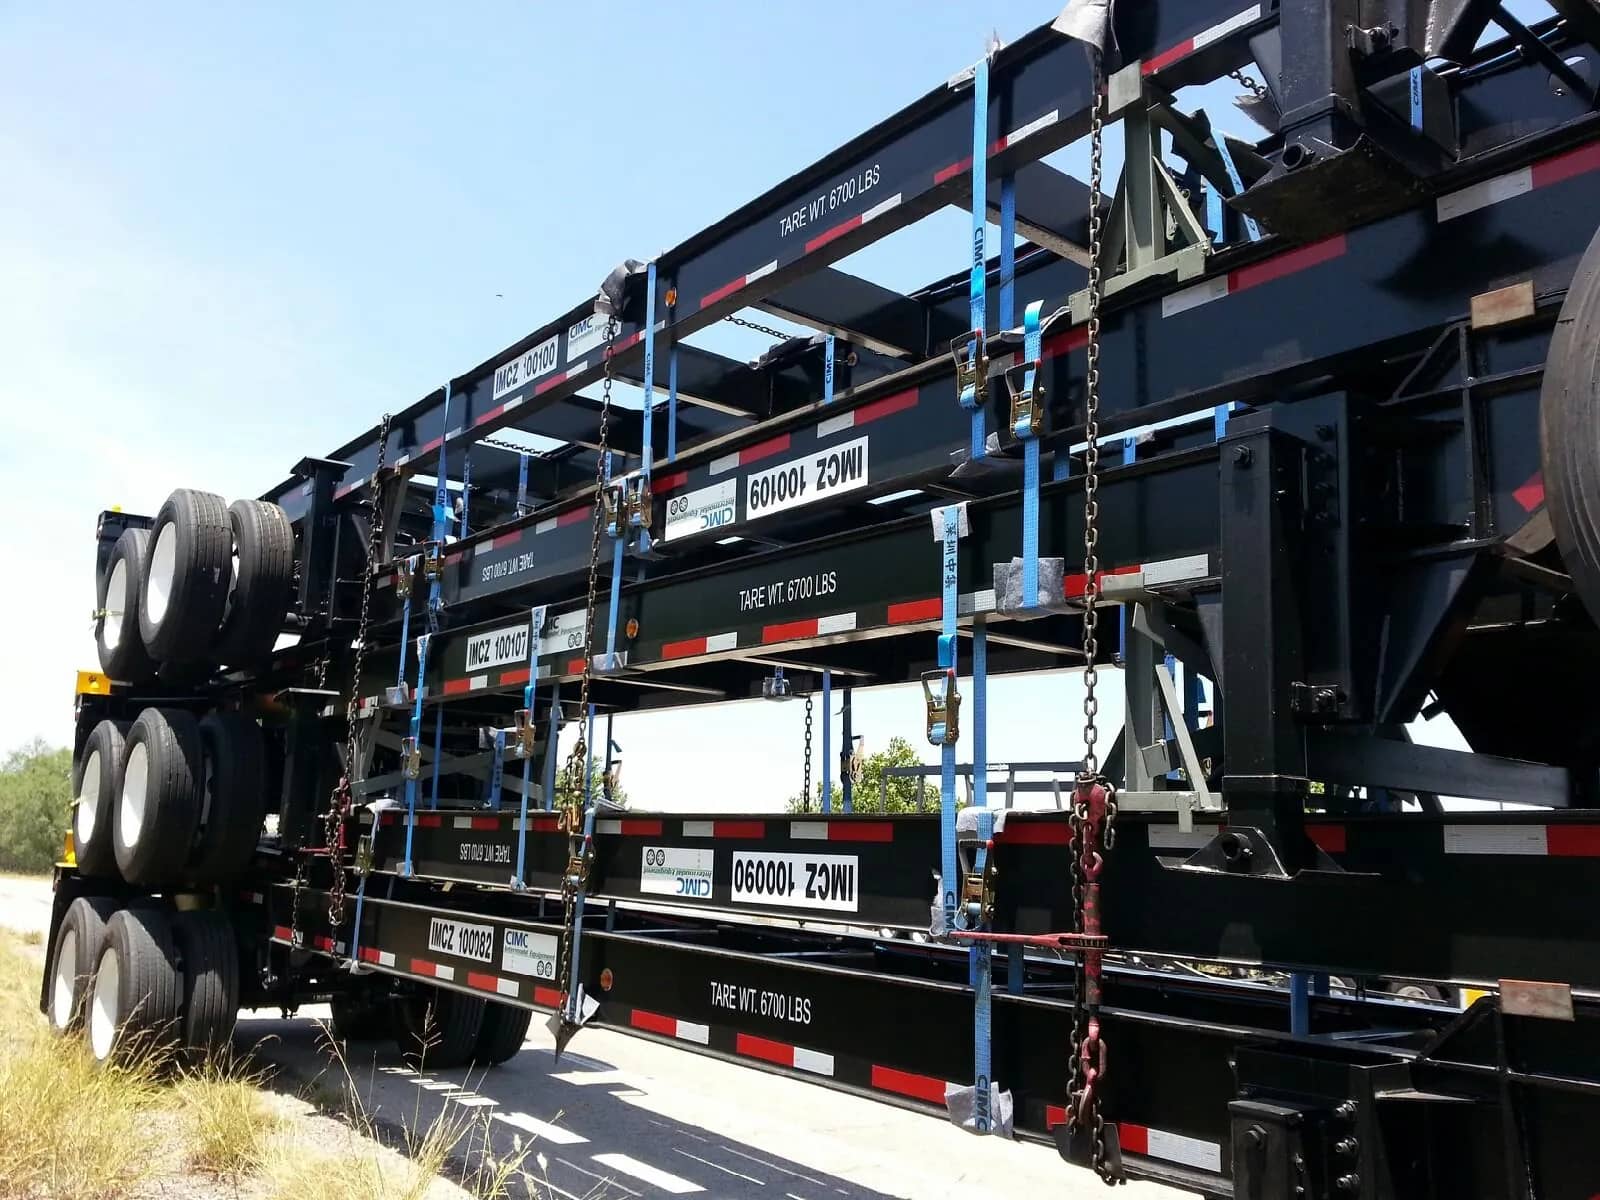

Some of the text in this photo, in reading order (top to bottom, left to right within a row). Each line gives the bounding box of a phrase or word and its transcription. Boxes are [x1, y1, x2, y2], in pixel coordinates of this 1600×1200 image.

[779, 164, 880, 238] TARE WT. 6700 LBS
[570, 315, 594, 339] CIMC
[495, 341, 555, 394] IMCZ 100100
[750, 445, 863, 510] IMCZ 100109
[700, 507, 734, 530] CIMC
[739, 571, 837, 612] TARE WT. 6700 LBS
[468, 631, 527, 667] IMCZ 100107
[676, 877, 711, 897] CIMC
[734, 858, 854, 902] IMCZ 100090
[945, 890, 956, 930] CIM
[431, 920, 492, 960] IMCZ 100082
[505, 930, 529, 949] CIMC
[710, 981, 812, 1025] TARE WT. 6700 LBS
[977, 1074, 988, 1132] CIMC
